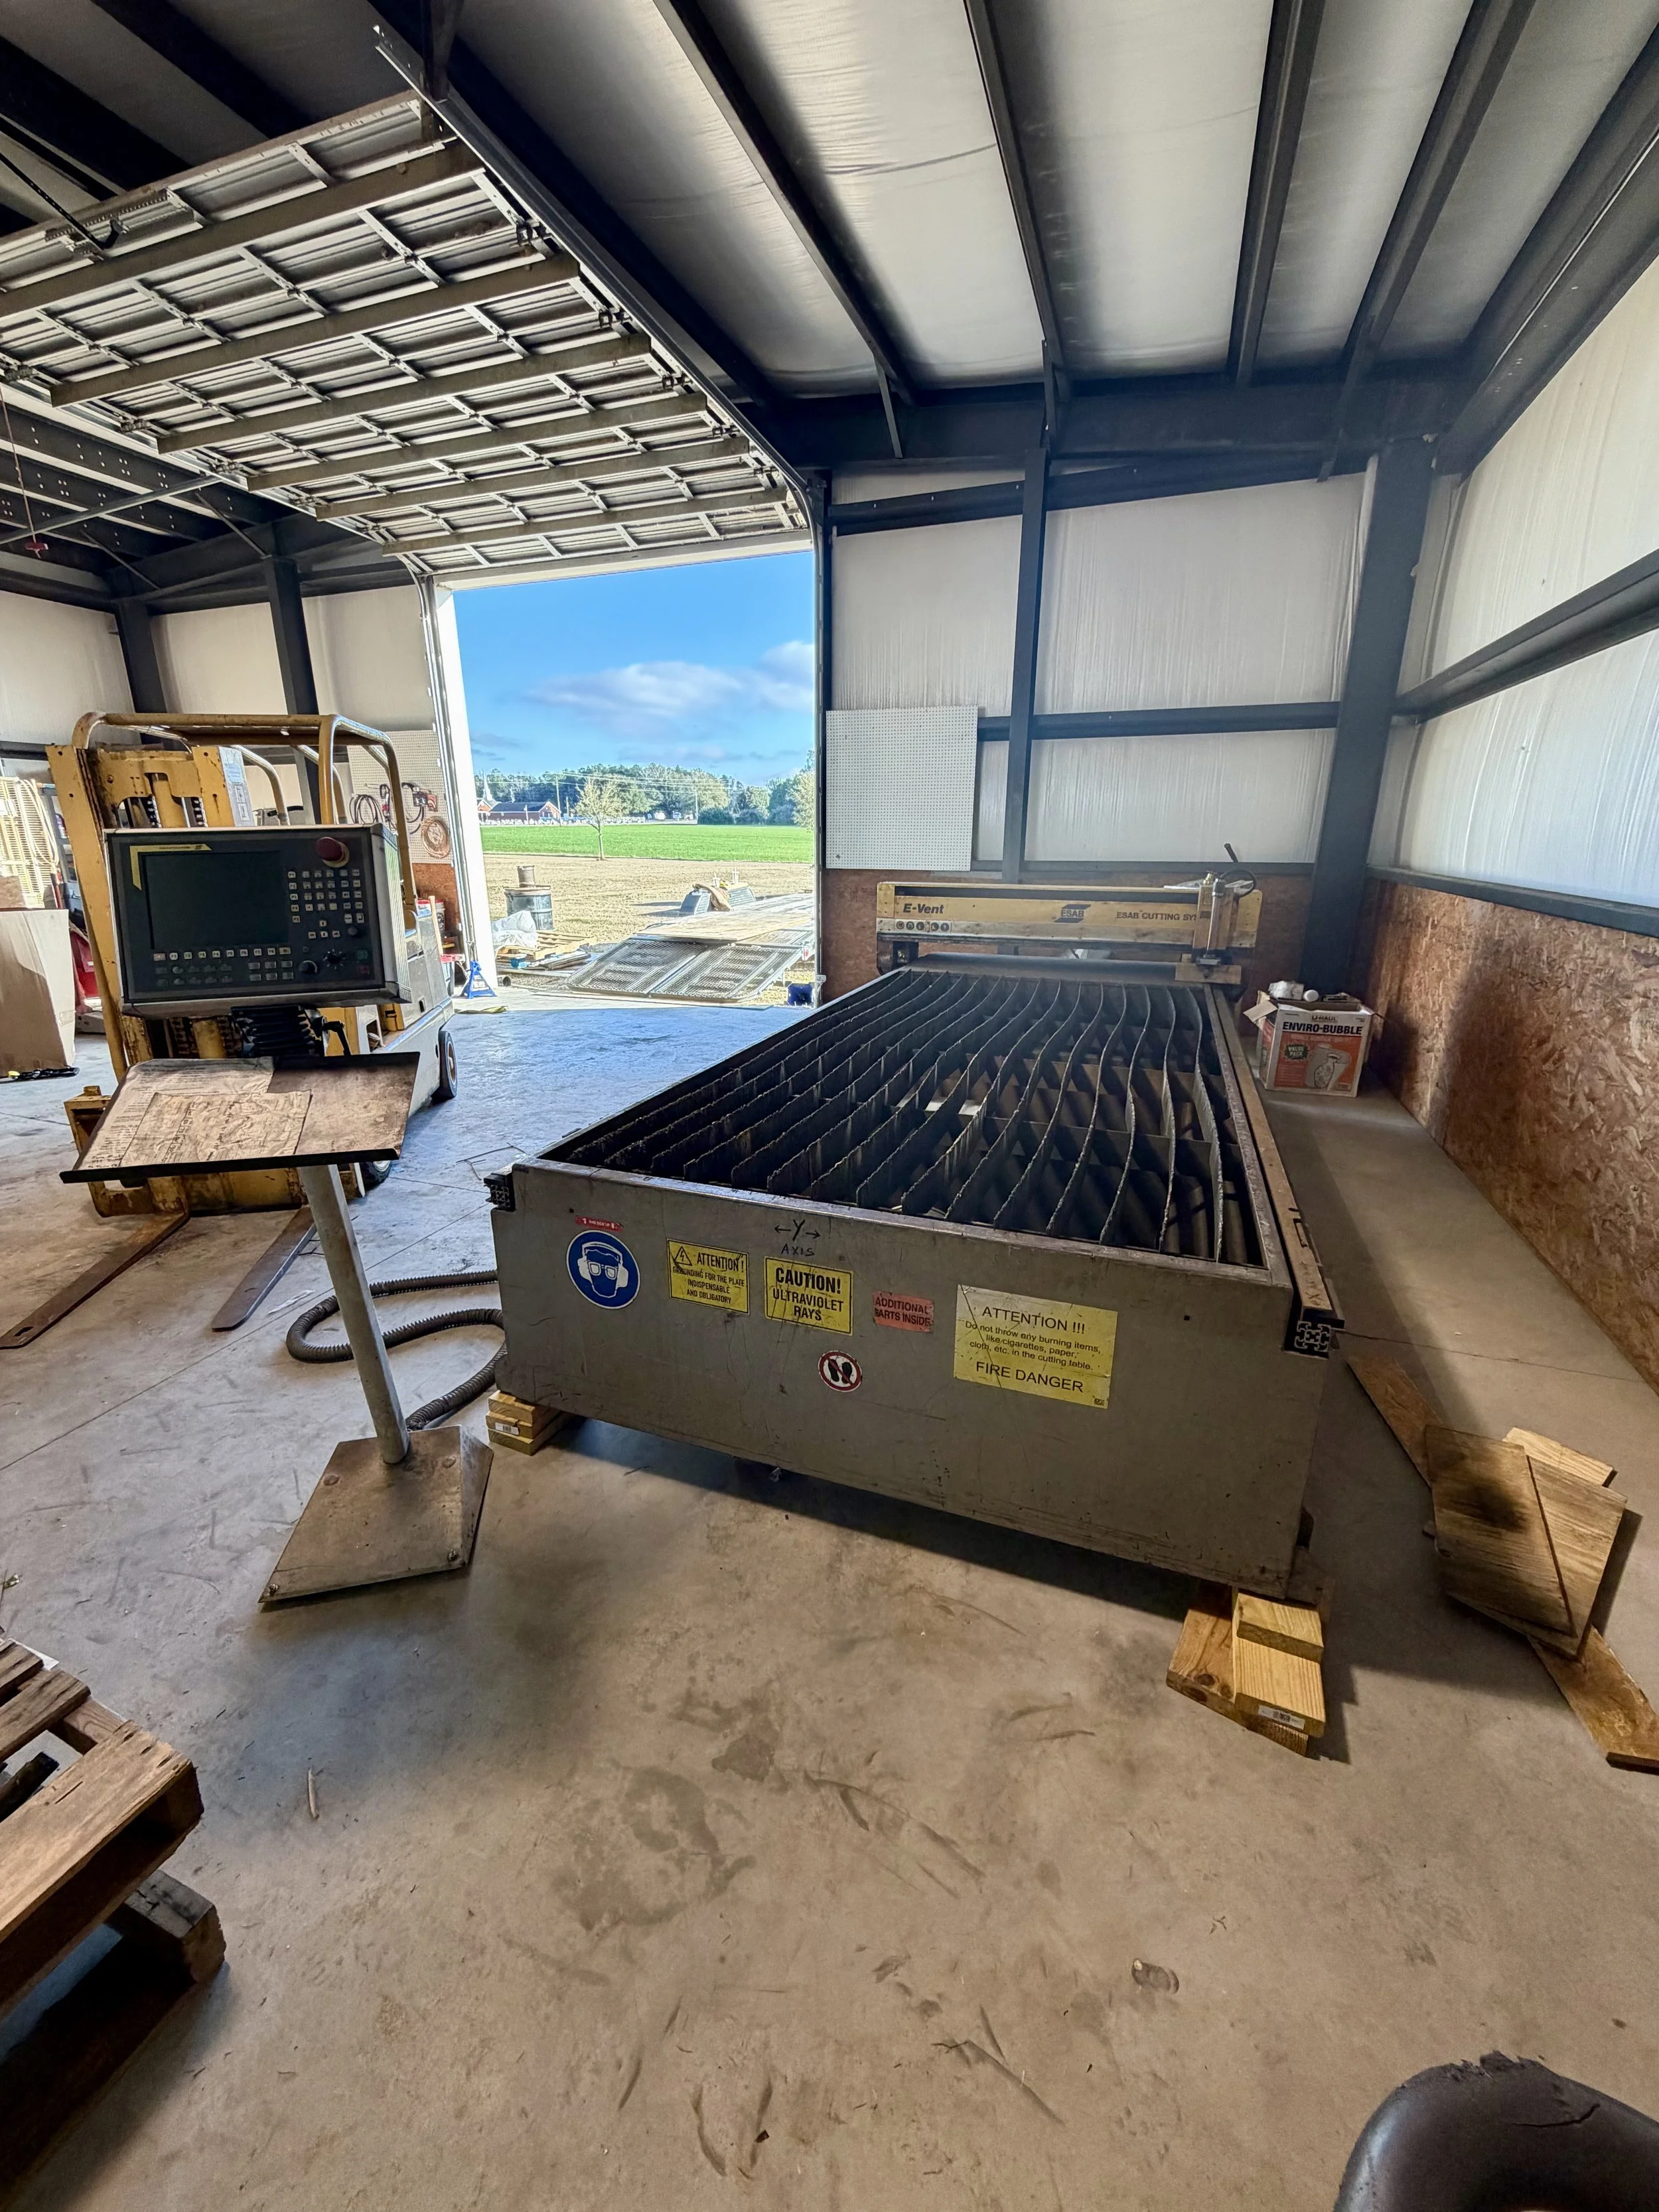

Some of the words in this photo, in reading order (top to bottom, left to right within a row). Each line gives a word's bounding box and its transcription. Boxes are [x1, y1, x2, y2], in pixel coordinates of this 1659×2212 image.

[903, 903, 944, 914] E-Vent
[1141, 912, 1180, 921] CUTTING
[1282, 1021, 1363, 1035] ENVIRO-BUBBLE
[792, 1219, 806, 1242] Y
[780, 1244, 815, 1256] AXIS
[697, 1252, 739, 1272] ATTENTION
[673, 1266, 703, 1278] GROUNDING
[705, 1272, 715, 1281] FOR
[717, 1275, 727, 1284] THE
[729, 1277, 745, 1287] PLATE
[687, 1278, 730, 1293] INDISPENSABLE
[776, 1267, 841, 1294] CAUTION!
[699, 1291, 732, 1304] OBLIGATORY
[772, 1287, 844, 1311] ULTRAVIOLET
[875, 1297, 930, 1315] ADDITIONAL
[794, 1305, 822, 1321] RAYS
[875, 1307, 901, 1321] PARTS
[902, 1313, 930, 1327] INSIDE
[982, 1306, 1068, 1331] ATTENTION
[1072, 1321, 1085, 1334] !!!
[966, 1321, 977, 1329] Do
[995, 1327, 1018, 1337] throw
[1021, 1333, 1037, 1342] any
[1039, 1335, 1072, 1349] burning
[1074, 1341, 1101, 1354] items,
[986, 1335, 1001, 1343] like
[1003, 1337, 1046, 1353] cigarettes,
[1049, 1347, 1077, 1359] paper,
[970, 1341, 991, 1351] cloth,
[1022, 1350, 1035, 1359] the
[1038, 1355, 1066, 1366] cutting
[1069, 1359, 1094, 1370] table.
[976, 1361, 1011, 1378] FIRE
[1016, 1369, 1083, 1393] DANGER
